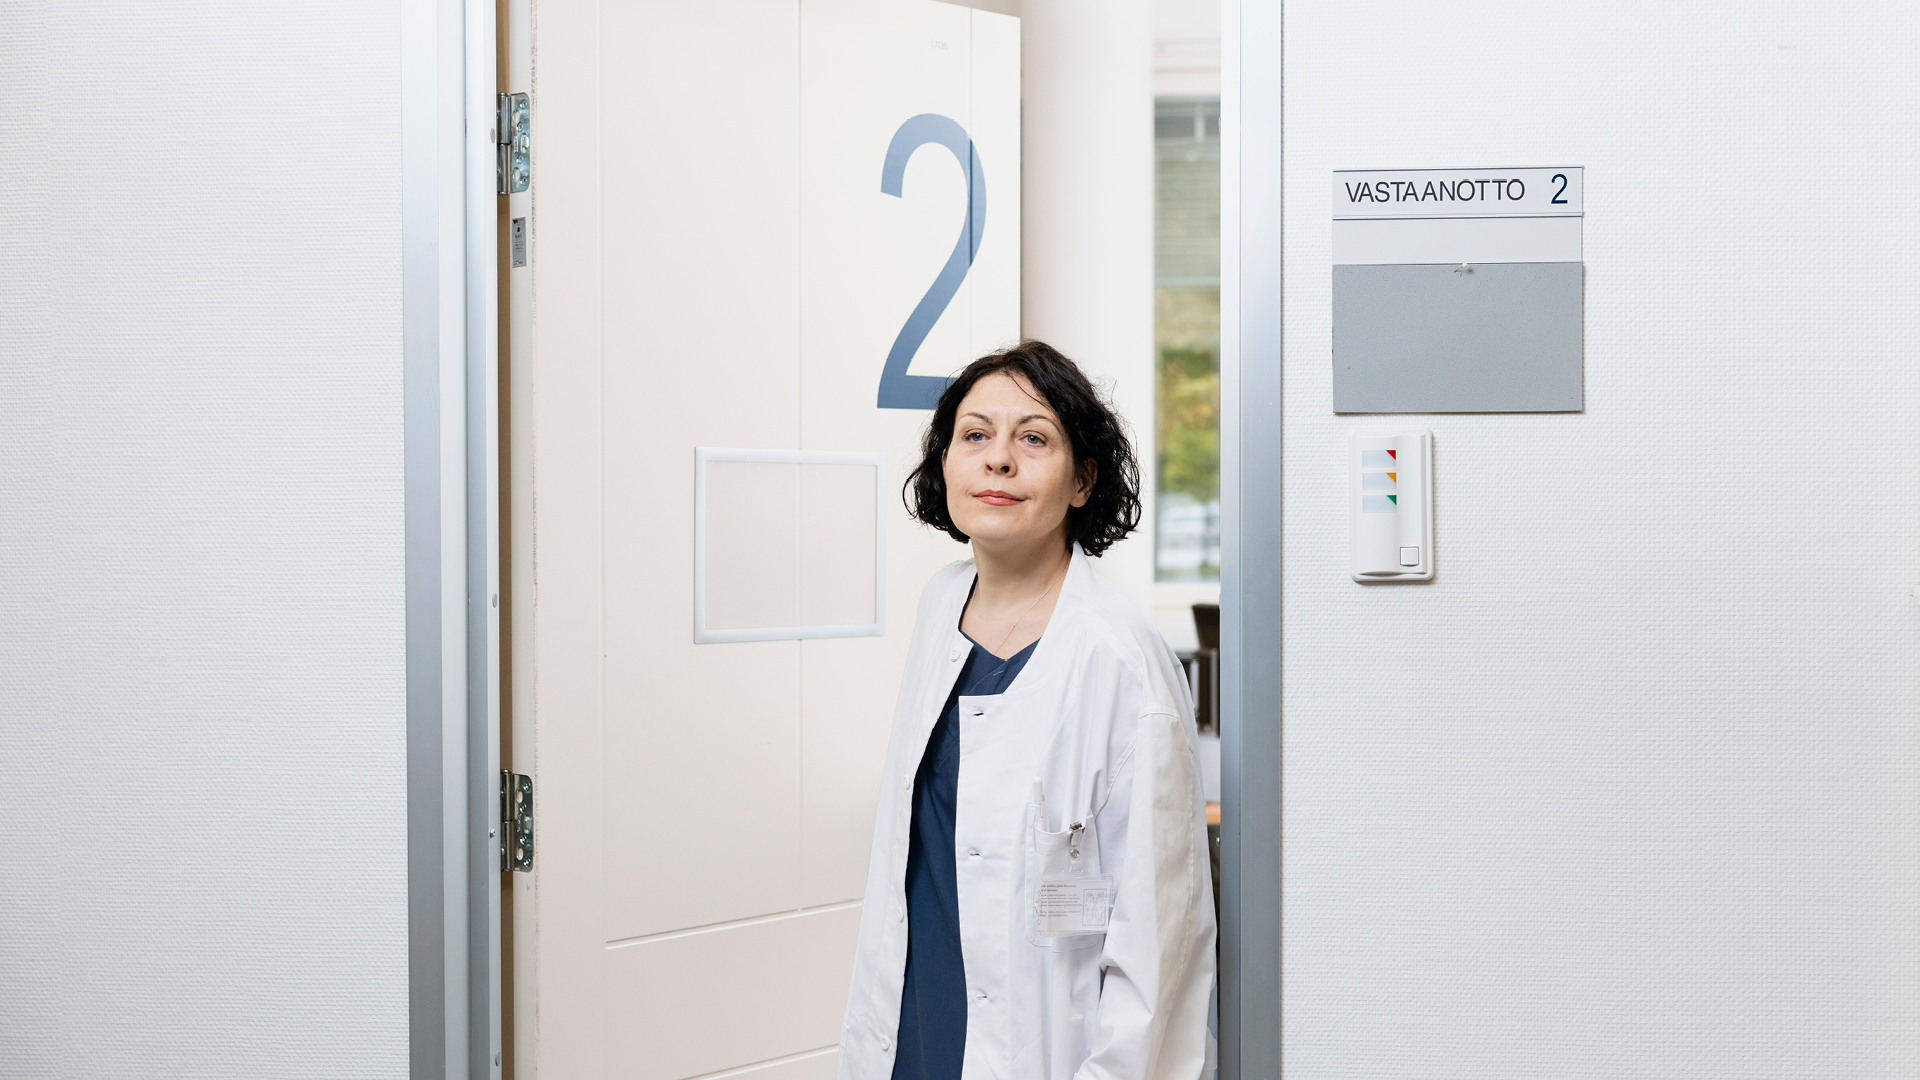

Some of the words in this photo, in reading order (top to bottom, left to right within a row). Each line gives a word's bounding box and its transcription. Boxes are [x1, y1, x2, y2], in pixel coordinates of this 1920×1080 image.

[877, 113, 986, 410] 2
[1345, 179, 1526, 203] VASTAANOTTO
[1550, 173, 1568, 204] 2
